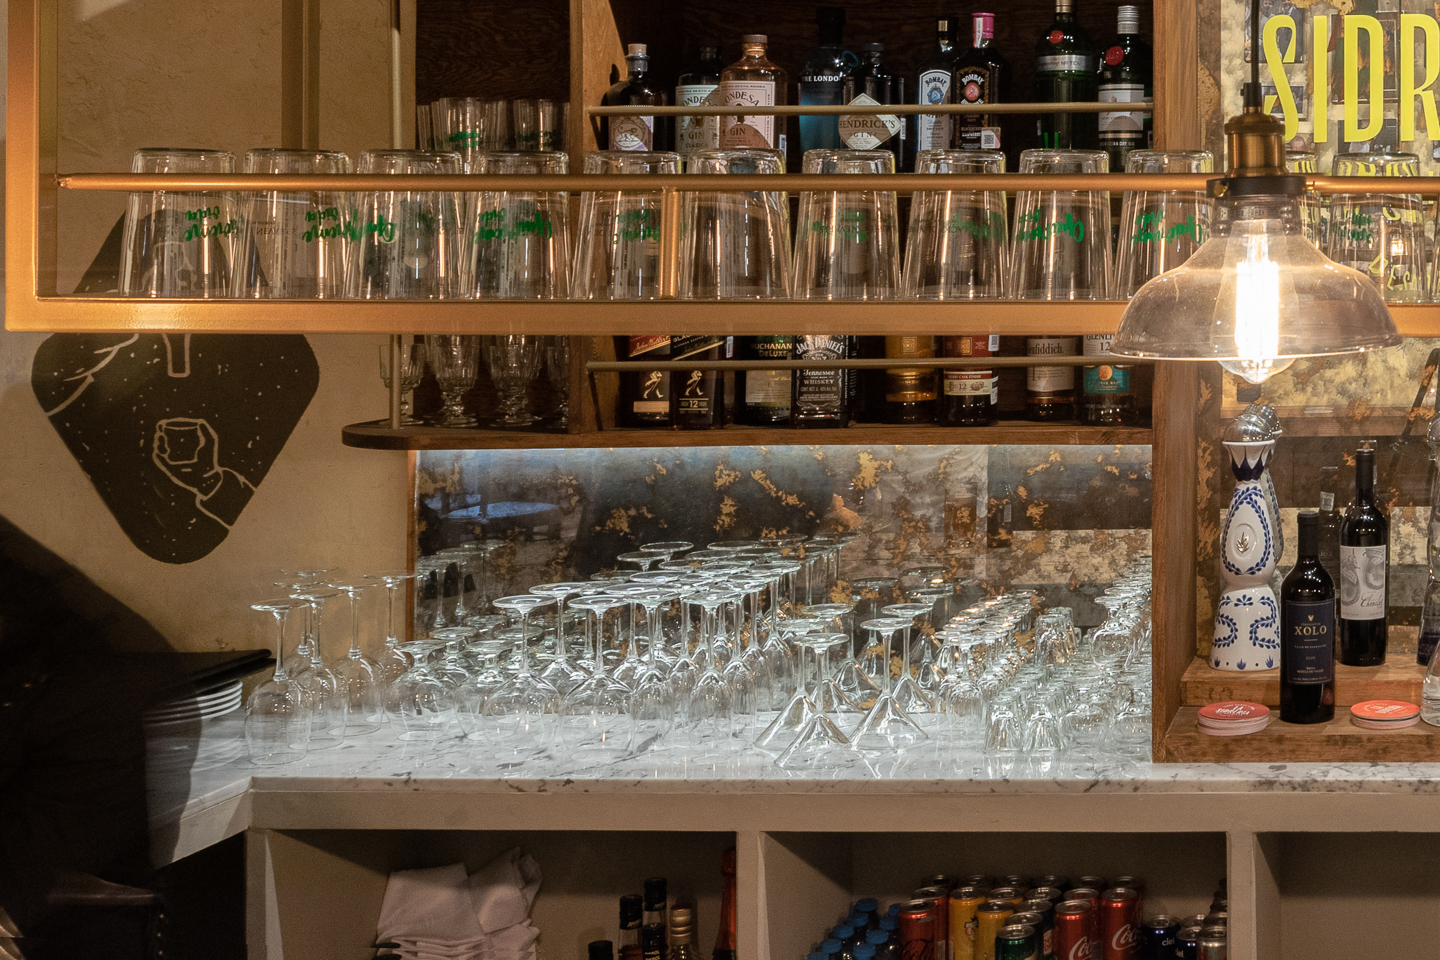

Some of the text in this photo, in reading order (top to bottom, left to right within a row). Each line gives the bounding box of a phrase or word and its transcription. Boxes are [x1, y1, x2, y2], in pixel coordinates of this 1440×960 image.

[925, 76, 947, 87] BOMBAY
[961, 73, 984, 85] BOMBAY
[730, 128, 746, 136] GIN
[1100, 342, 1110, 351] 12
[1294, 625, 1327, 636] XOLO
